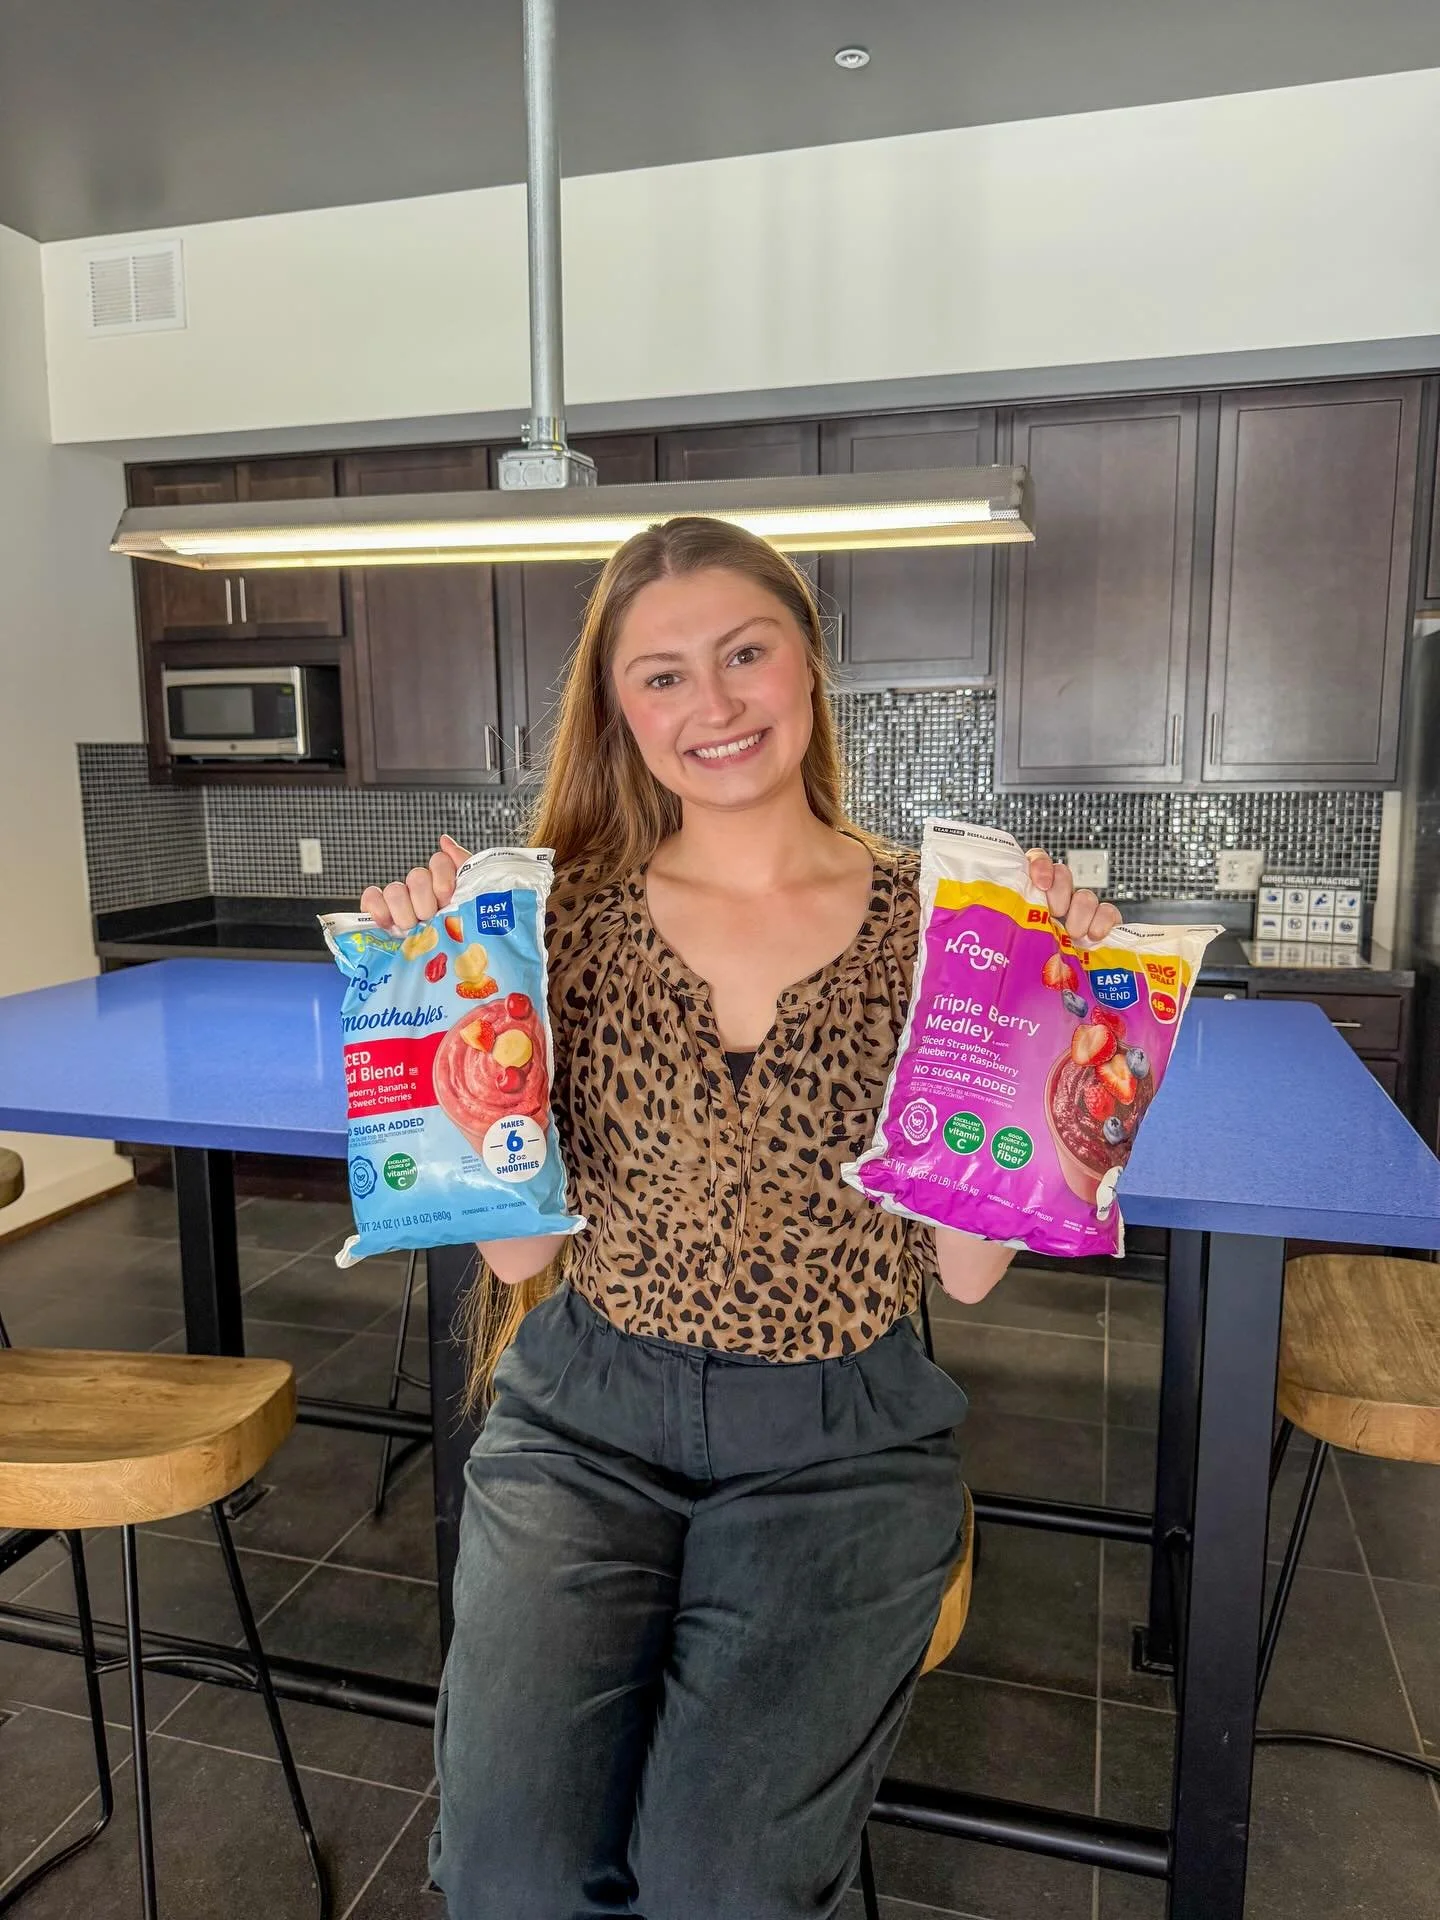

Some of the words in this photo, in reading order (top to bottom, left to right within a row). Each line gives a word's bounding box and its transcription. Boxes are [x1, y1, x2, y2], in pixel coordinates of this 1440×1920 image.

[967, 832, 998, 843] RESEALABLE
[1285, 875, 1314, 885] HEALTH
[1316, 876, 1360, 886] PRACTICES
[480, 901, 507, 914] EASY
[481, 919, 508, 929] BLEND
[1027, 909, 1049, 924] BI
[944, 930, 1010, 970] Kroger
[1146, 963, 1176, 978] BIG
[1097, 974, 1129, 985] EASY
[1151, 973, 1175, 985] DEAL!
[1098, 991, 1131, 1001] BLEND
[341, 1004, 443, 1032] moothables
[932, 993, 983, 1016] Triple
[988, 1005, 1040, 1036] Berry
[924, 1013, 994, 1043] Medley
[946, 1038, 1001, 1061] Strawberry,
[344, 1051, 371, 1068] CED
[961, 1053, 967, 1062] &
[969, 1054, 1019, 1077] Raspberry
[360, 1061, 404, 1081] Blend
[378, 1082, 409, 1093] Banana
[410, 1082, 417, 1090] &
[913, 1064, 929, 1074] NO
[930, 1067, 971, 1083] SUGAR
[973, 1076, 1016, 1096] ADDED
[352, 1097, 377, 1108] Sweet
[378, 1093, 413, 1104] Cherries
[910, 1104, 931, 1114] QUALITY
[353, 1123, 386, 1136] SUGAR
[388, 1117, 425, 1131] ADDED
[500, 1119, 525, 1129] MAKES
[952, 1121, 972, 1130] SOURCE
[953, 1116, 981, 1127] EXCELLENT
[506, 1129, 524, 1152] 6
[948, 1127, 980, 1142] vitamin
[1000, 1135, 1020, 1146] SOURCE
[1007, 1132, 1024, 1141] GOOD
[956, 1139, 967, 1150] C
[997, 1141, 1027, 1157] dietary
[996, 1151, 1023, 1166] fiber
[387, 1166, 416, 1178] vitamin
[496, 1160, 540, 1174] SMOOTHIES
[398, 1177, 407, 1187] C
[895, 1160, 906, 1174] WT
[917, 1170, 929, 1180] OZ
[929, 1174, 937, 1183] (3
[938, 1176, 951, 1188] LB)
[969, 1185, 980, 1197] kg
[372, 1219, 382, 1231] 24
[383, 1218, 393, 1229] OZ
[394, 1217, 400, 1230] (1
[402, 1215, 412, 1226] LB
[413, 1214, 419, 1225] 8
[419, 1212, 432, 1224] OZ)
[433, 1210, 452, 1222] 680g
[1022, 1207, 1034, 1215] KEEP
[1034, 1210, 1054, 1222] FROZEN
